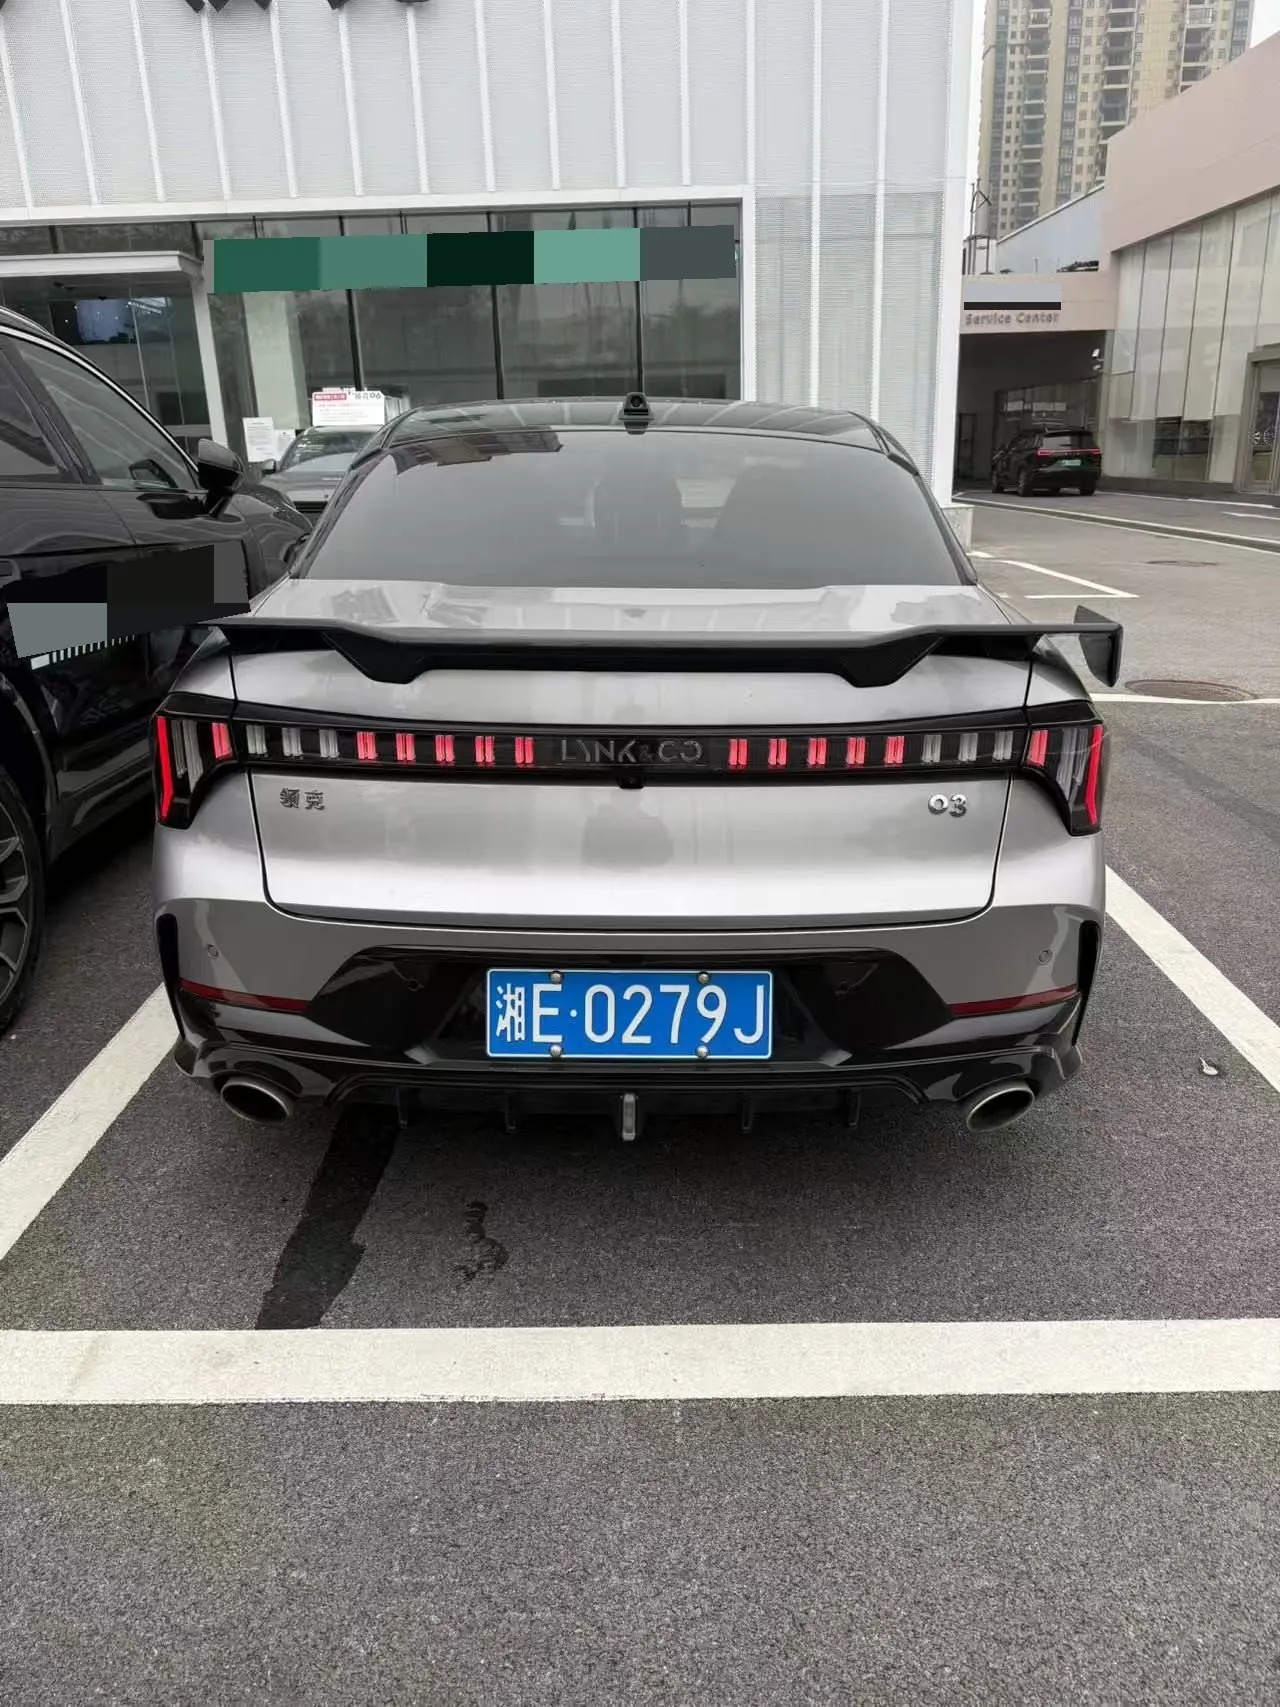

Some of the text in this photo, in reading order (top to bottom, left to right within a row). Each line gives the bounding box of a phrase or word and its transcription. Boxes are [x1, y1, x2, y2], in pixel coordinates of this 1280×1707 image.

[966, 312, 1060, 325] Service Center
[280, 788, 325, 810] 领克
[928, 794, 967, 818] 03
[496, 983, 764, 1045] 湘E·0279J
